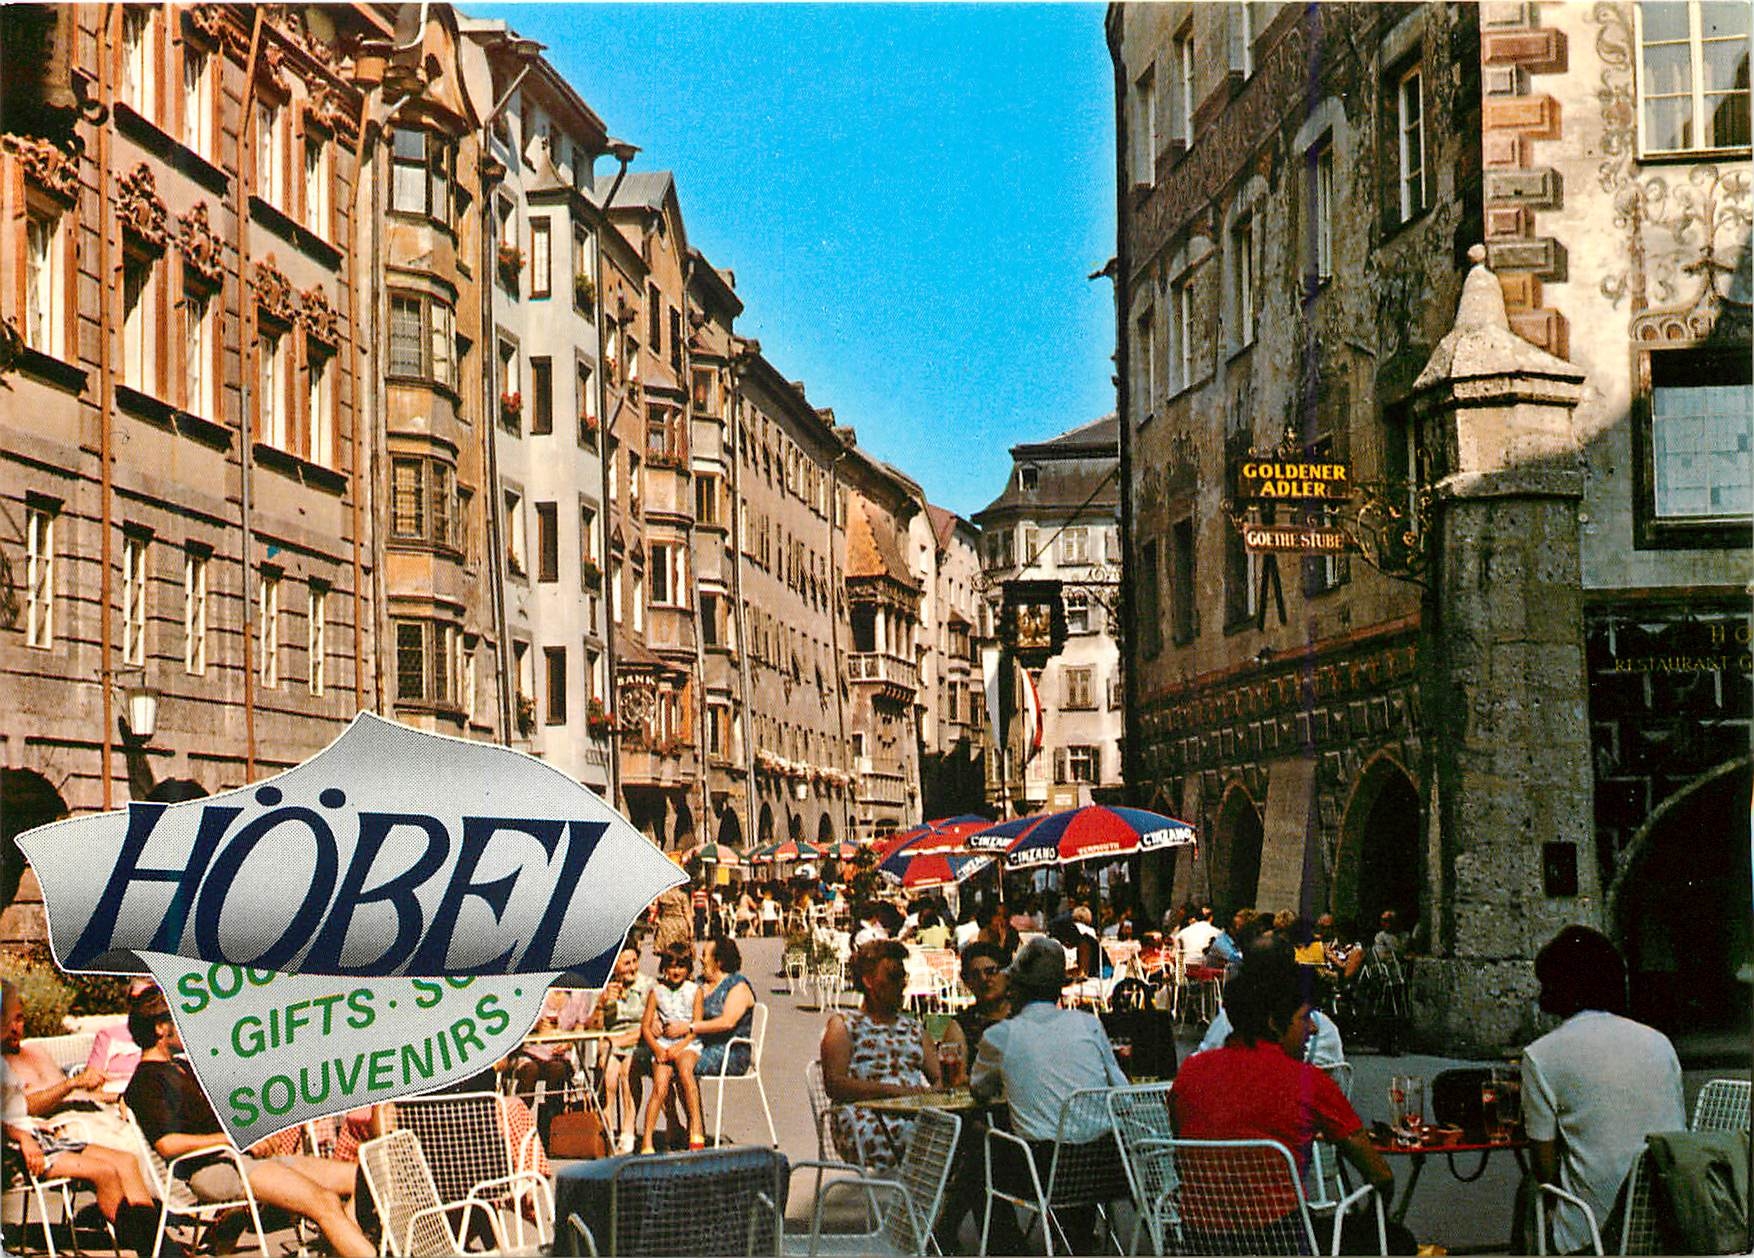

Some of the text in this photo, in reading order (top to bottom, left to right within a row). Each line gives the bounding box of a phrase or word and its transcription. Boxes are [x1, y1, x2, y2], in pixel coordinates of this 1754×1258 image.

[1242, 463, 1346, 480] GOLDENER
[1260, 481, 1326, 498] ADLER
[1247, 530, 1344, 549] GOETHE STUBE
[617, 675, 656, 686] BANK
[970, 836, 1014, 848] CINZAN
[1142, 828, 1191, 846] CINZANO
[1009, 847, 1056, 865] CINZANO
